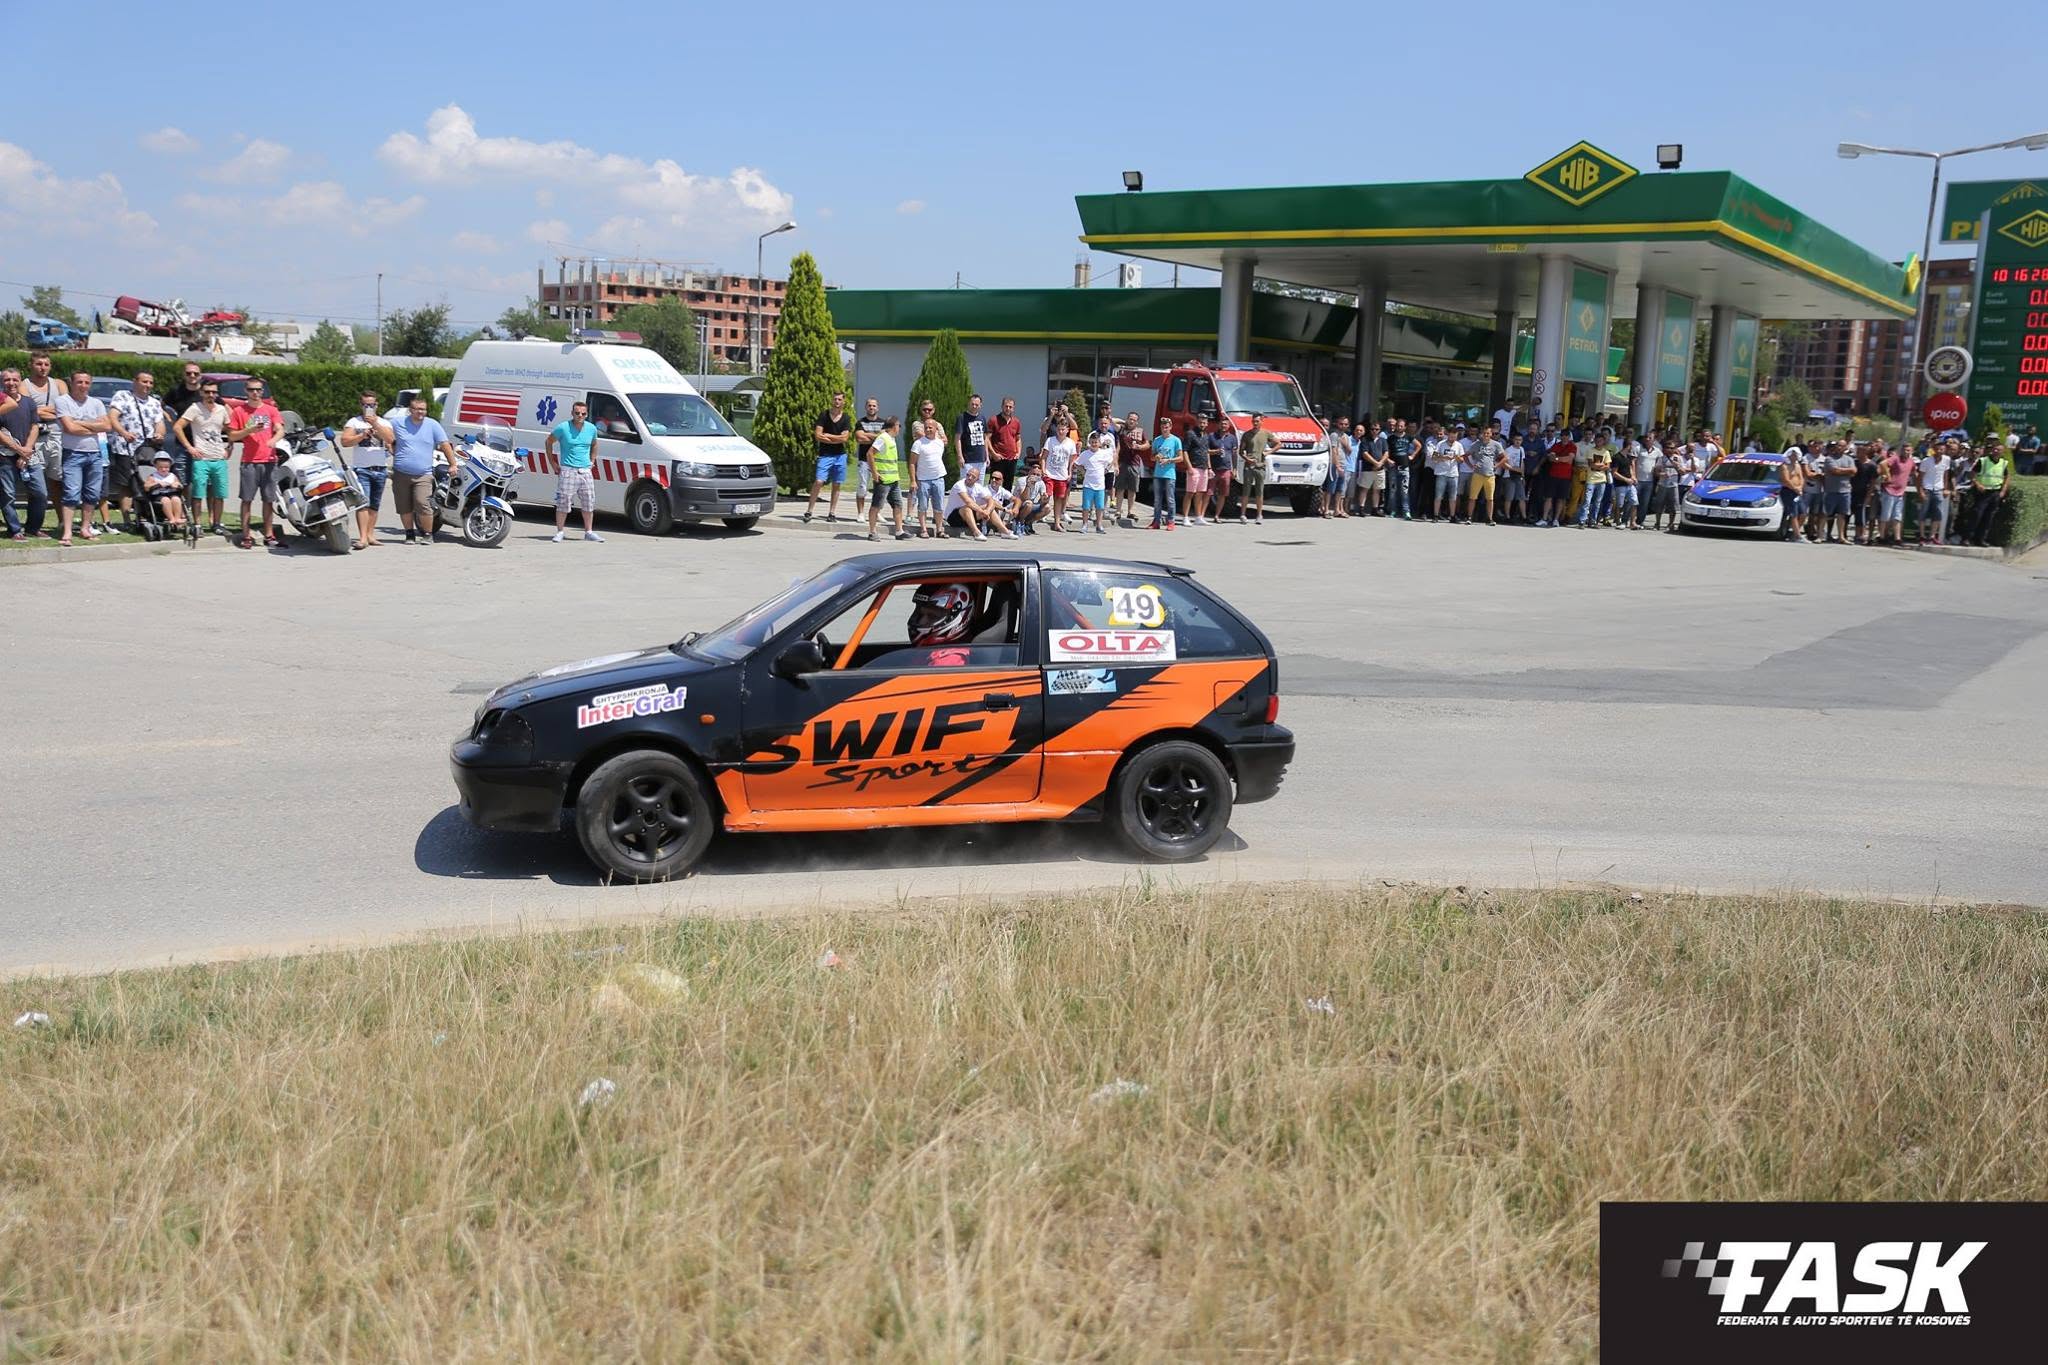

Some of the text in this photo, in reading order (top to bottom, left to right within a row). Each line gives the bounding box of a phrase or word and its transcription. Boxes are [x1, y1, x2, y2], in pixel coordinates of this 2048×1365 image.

[1569, 337, 1598, 353] PETROL
[1115, 592, 1155, 620] 49
[1058, 635, 1161, 652] OLTA
[595, 685, 667, 704] SHTYPSHKRONJA
[580, 689, 685, 725] InterGraf
